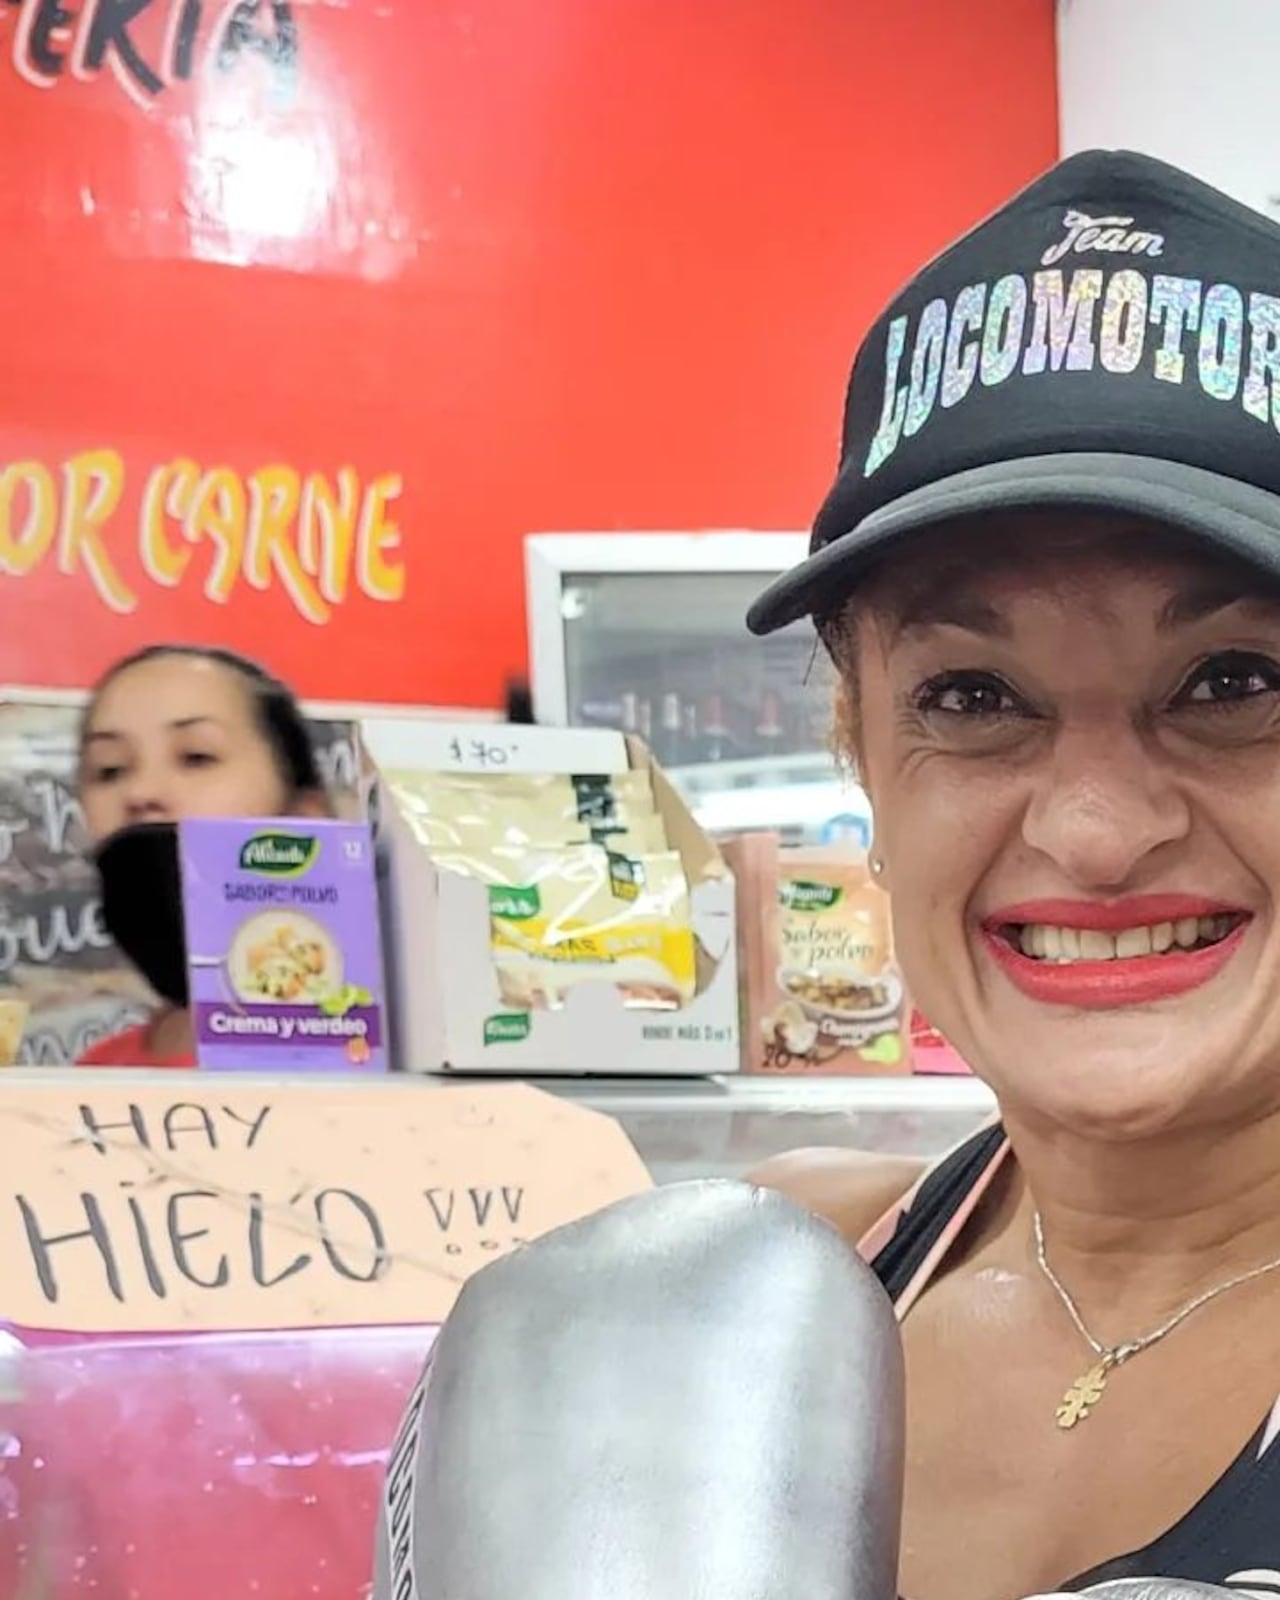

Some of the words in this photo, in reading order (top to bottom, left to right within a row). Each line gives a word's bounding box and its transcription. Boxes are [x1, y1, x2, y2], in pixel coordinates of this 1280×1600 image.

[1041, 208, 1165, 267] Team
[140, 457, 404, 624] CARNE
[209, 1011, 278, 1034] Crema
[278, 1017, 294, 1039] y
[296, 1014, 368, 1036] verdeo
[79, 1102, 271, 1154] HAY
